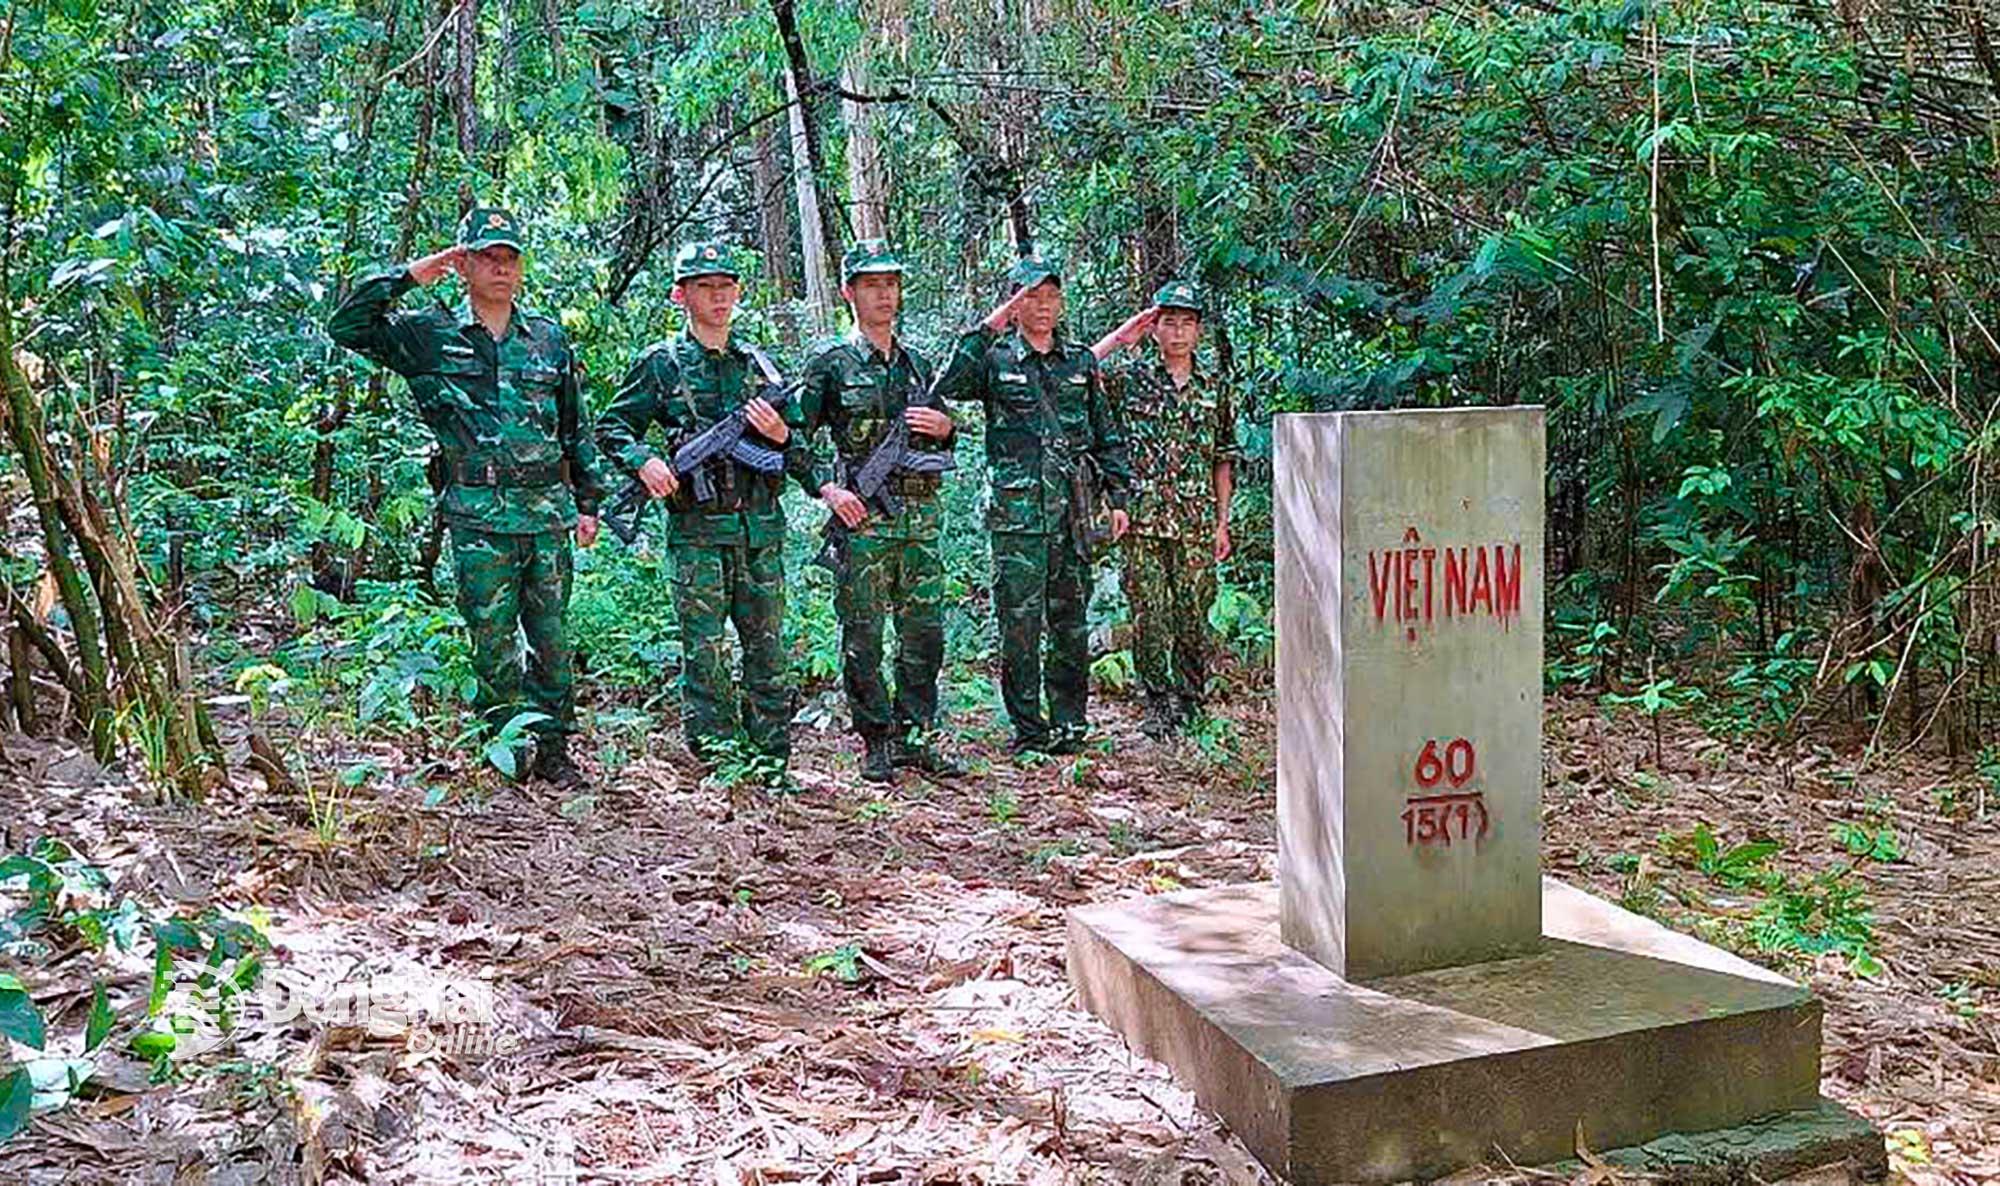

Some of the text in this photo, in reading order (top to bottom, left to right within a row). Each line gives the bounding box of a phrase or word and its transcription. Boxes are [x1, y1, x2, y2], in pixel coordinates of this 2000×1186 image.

[1368, 527, 1521, 642] VIỆT NAM
[1415, 738, 1475, 788] 60
[1400, 801, 1488, 850] 15(1)
